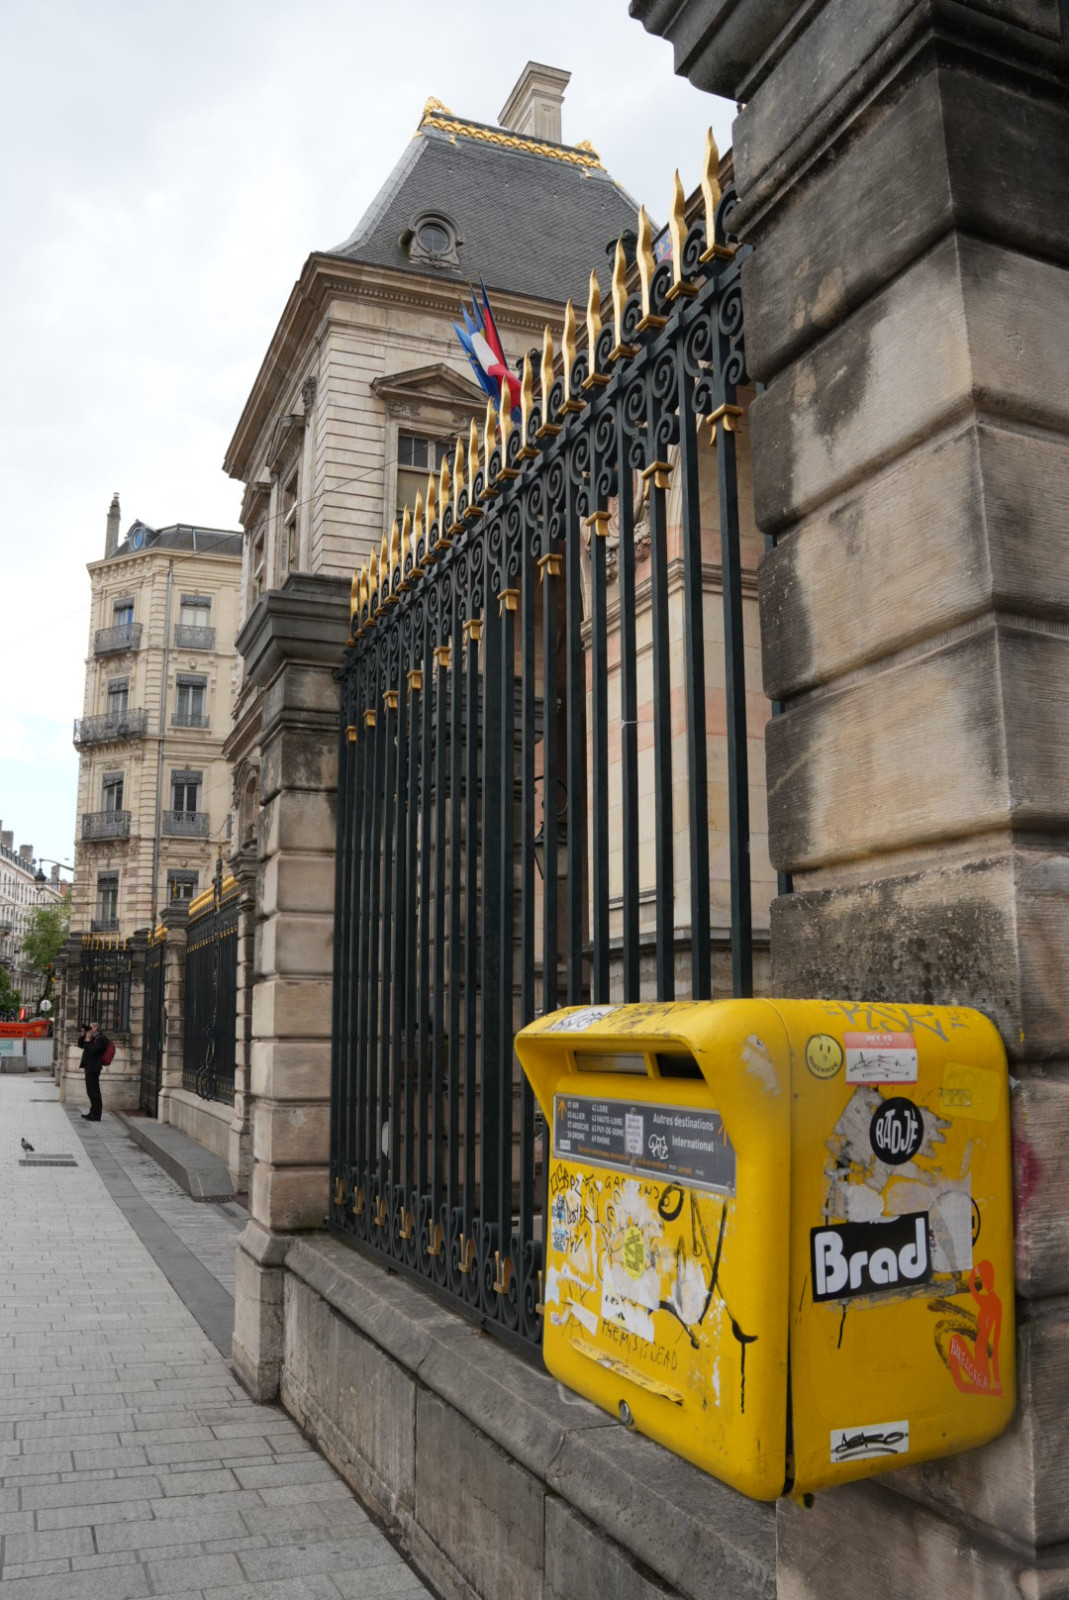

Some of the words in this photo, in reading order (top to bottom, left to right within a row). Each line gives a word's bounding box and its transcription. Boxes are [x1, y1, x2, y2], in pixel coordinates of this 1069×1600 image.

[597, 1105, 608, 1113] LOIRE
[572, 1112, 585, 1120] ALLIER
[597, 1116, 623, 1126] HAUTE-LOIRE
[652, 1113, 673, 1125] Autres
[674, 1116, 714, 1131] destinations
[671, 1135, 714, 1152] International
[814, 1217, 928, 1295] Brad
